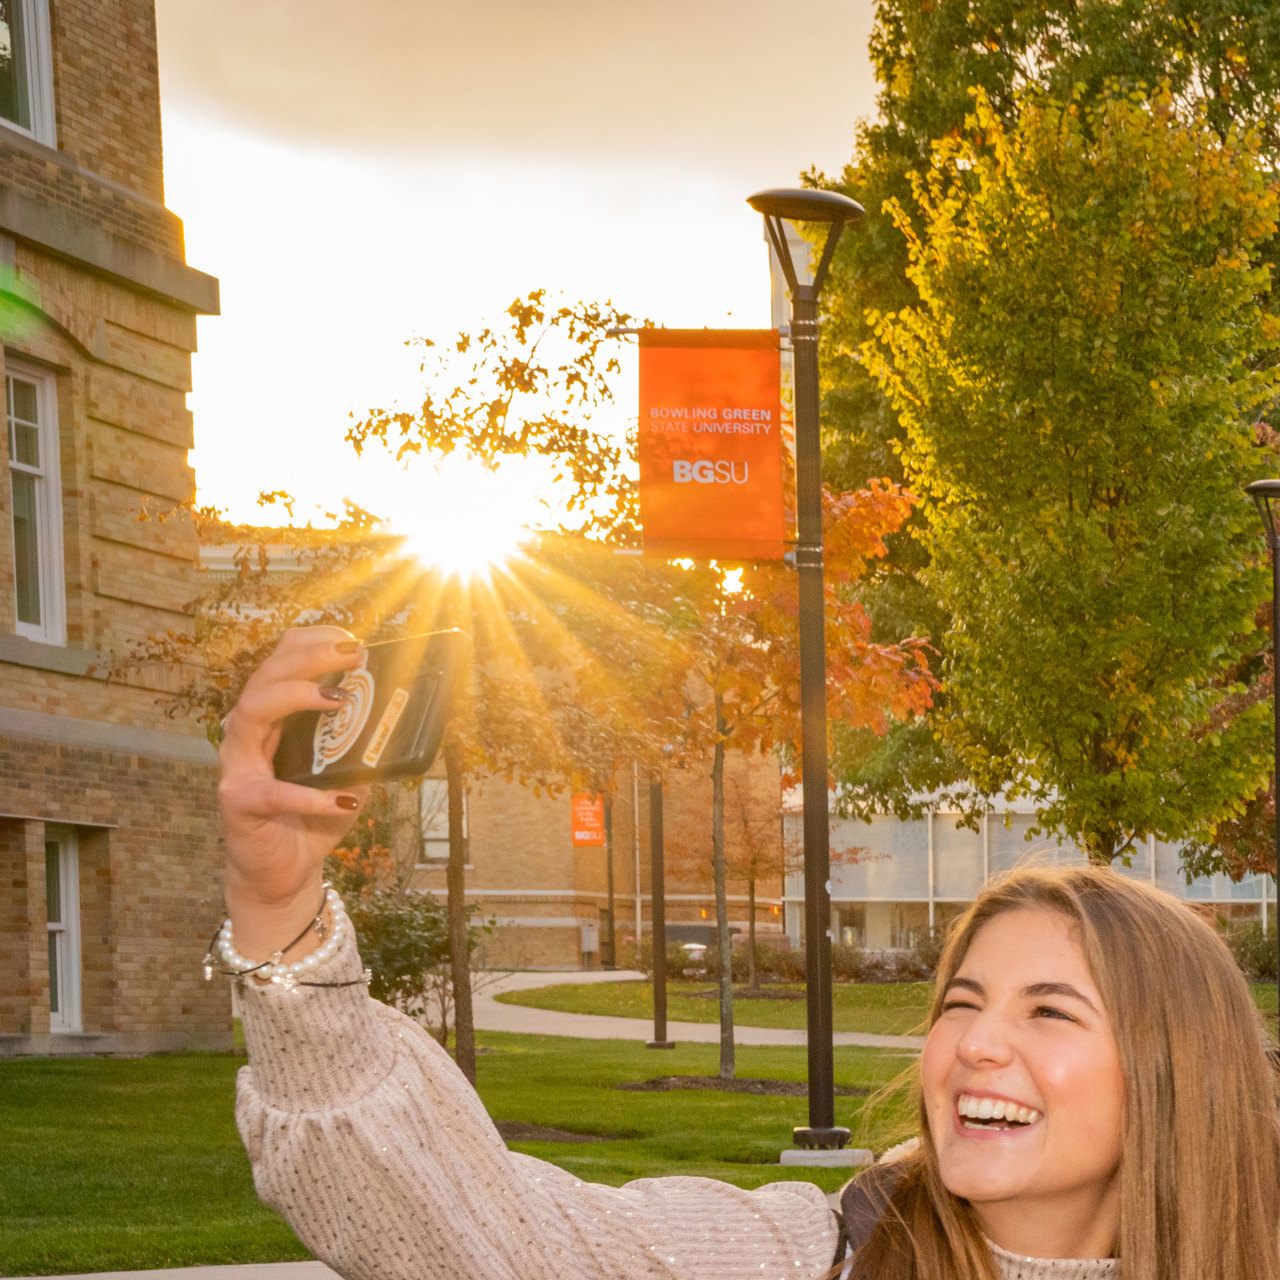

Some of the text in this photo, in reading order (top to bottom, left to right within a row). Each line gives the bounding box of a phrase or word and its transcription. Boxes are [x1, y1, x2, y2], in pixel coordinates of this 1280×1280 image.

[650, 407, 772, 421] BOWLING GREEN
[650, 422, 772, 435] STATE UNIVERSITY
[673, 460, 749, 484] BGSU
